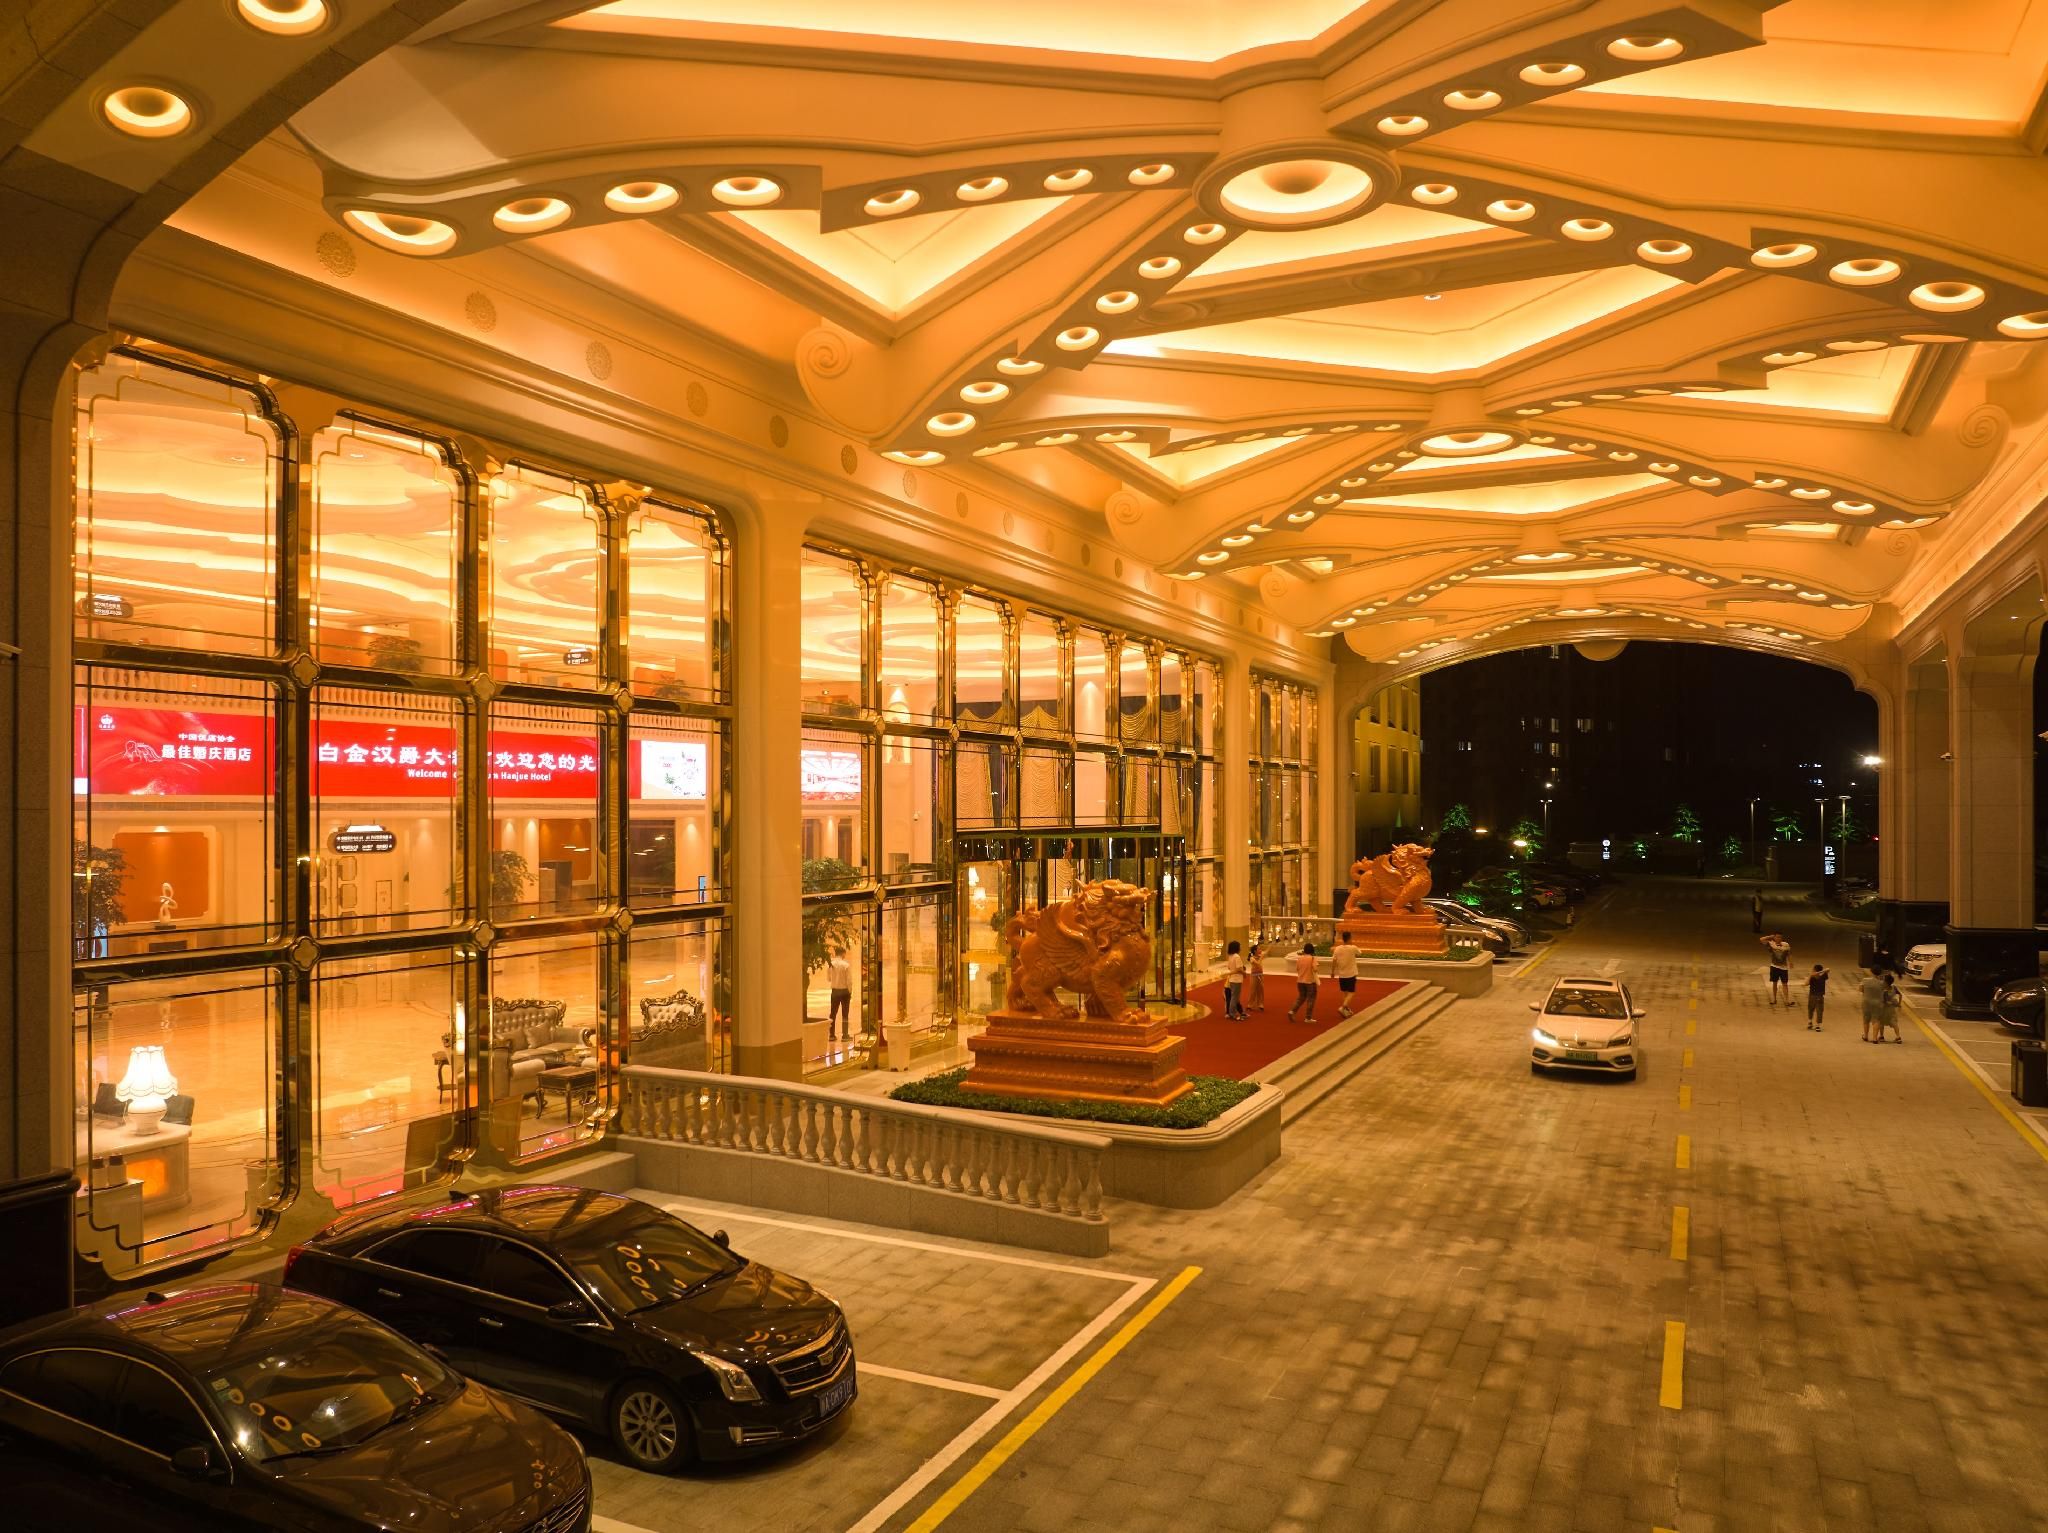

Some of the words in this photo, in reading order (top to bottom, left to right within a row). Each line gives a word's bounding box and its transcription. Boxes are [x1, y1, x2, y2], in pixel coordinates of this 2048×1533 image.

[161, 744, 252, 762] 最佳婚庆酒店
[407, 768, 448, 779] Welcome
[501, 771, 529, 782] Hanjue
[530, 772, 552, 782] Hotel
[1824, 846, 1833, 855] P
